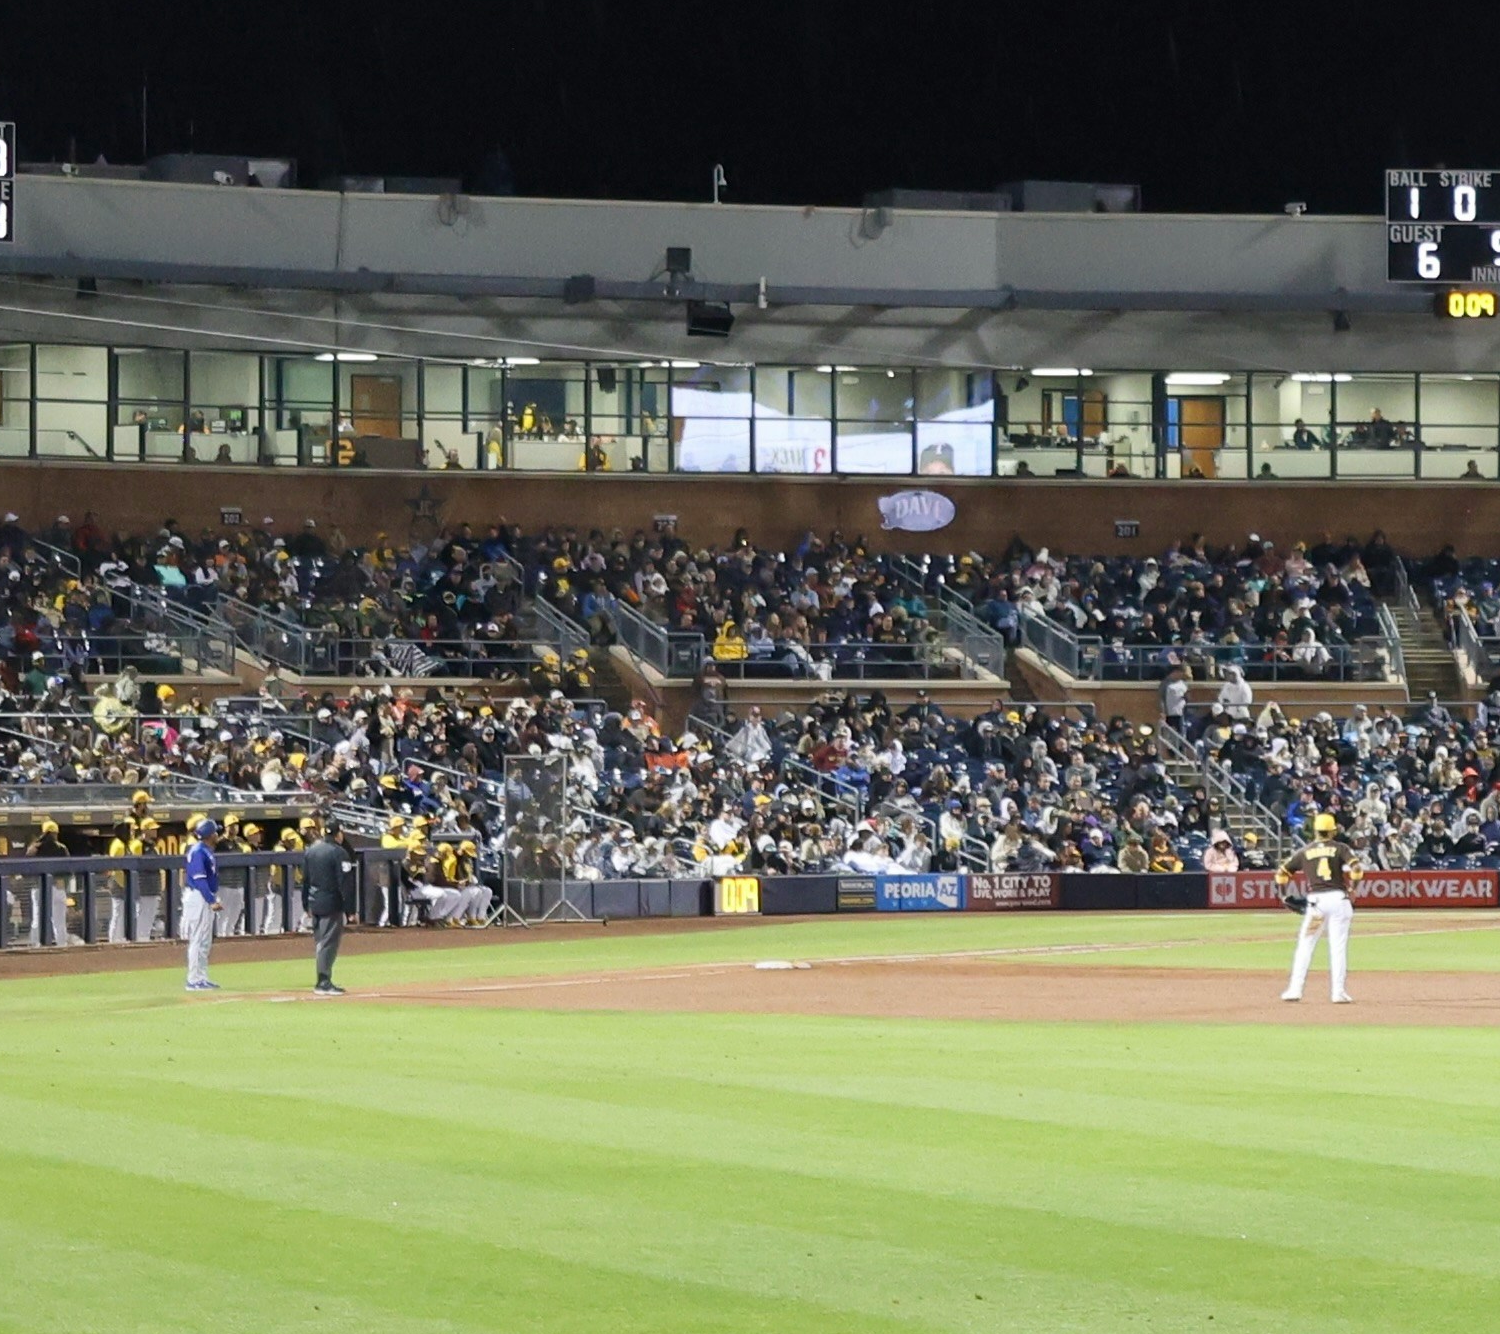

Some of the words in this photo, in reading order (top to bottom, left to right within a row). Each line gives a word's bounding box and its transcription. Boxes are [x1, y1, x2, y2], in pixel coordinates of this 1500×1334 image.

[1390, 171, 1428, 187] BALL
[1440, 172, 1492, 188] STRIKE
[1409, 188, 1420, 219] 1
[1454, 185, 1476, 222] 0
[1389, 225, 1445, 244] GUEST
[1417, 242, 1441, 279] 6
[1316, 856, 1332, 881] 4
[884, 882, 936, 899] PEORIA
[939, 882, 959, 898] AZ
[993, 875, 1000, 889] 1
[1001, 875, 1030, 889] CITY
[1031, 874, 1052, 888] TO
[1349, 879, 1493, 899] WORKWEAR
[993, 888, 1018, 899] WORK
[1027, 887, 1052, 898] PLAY
